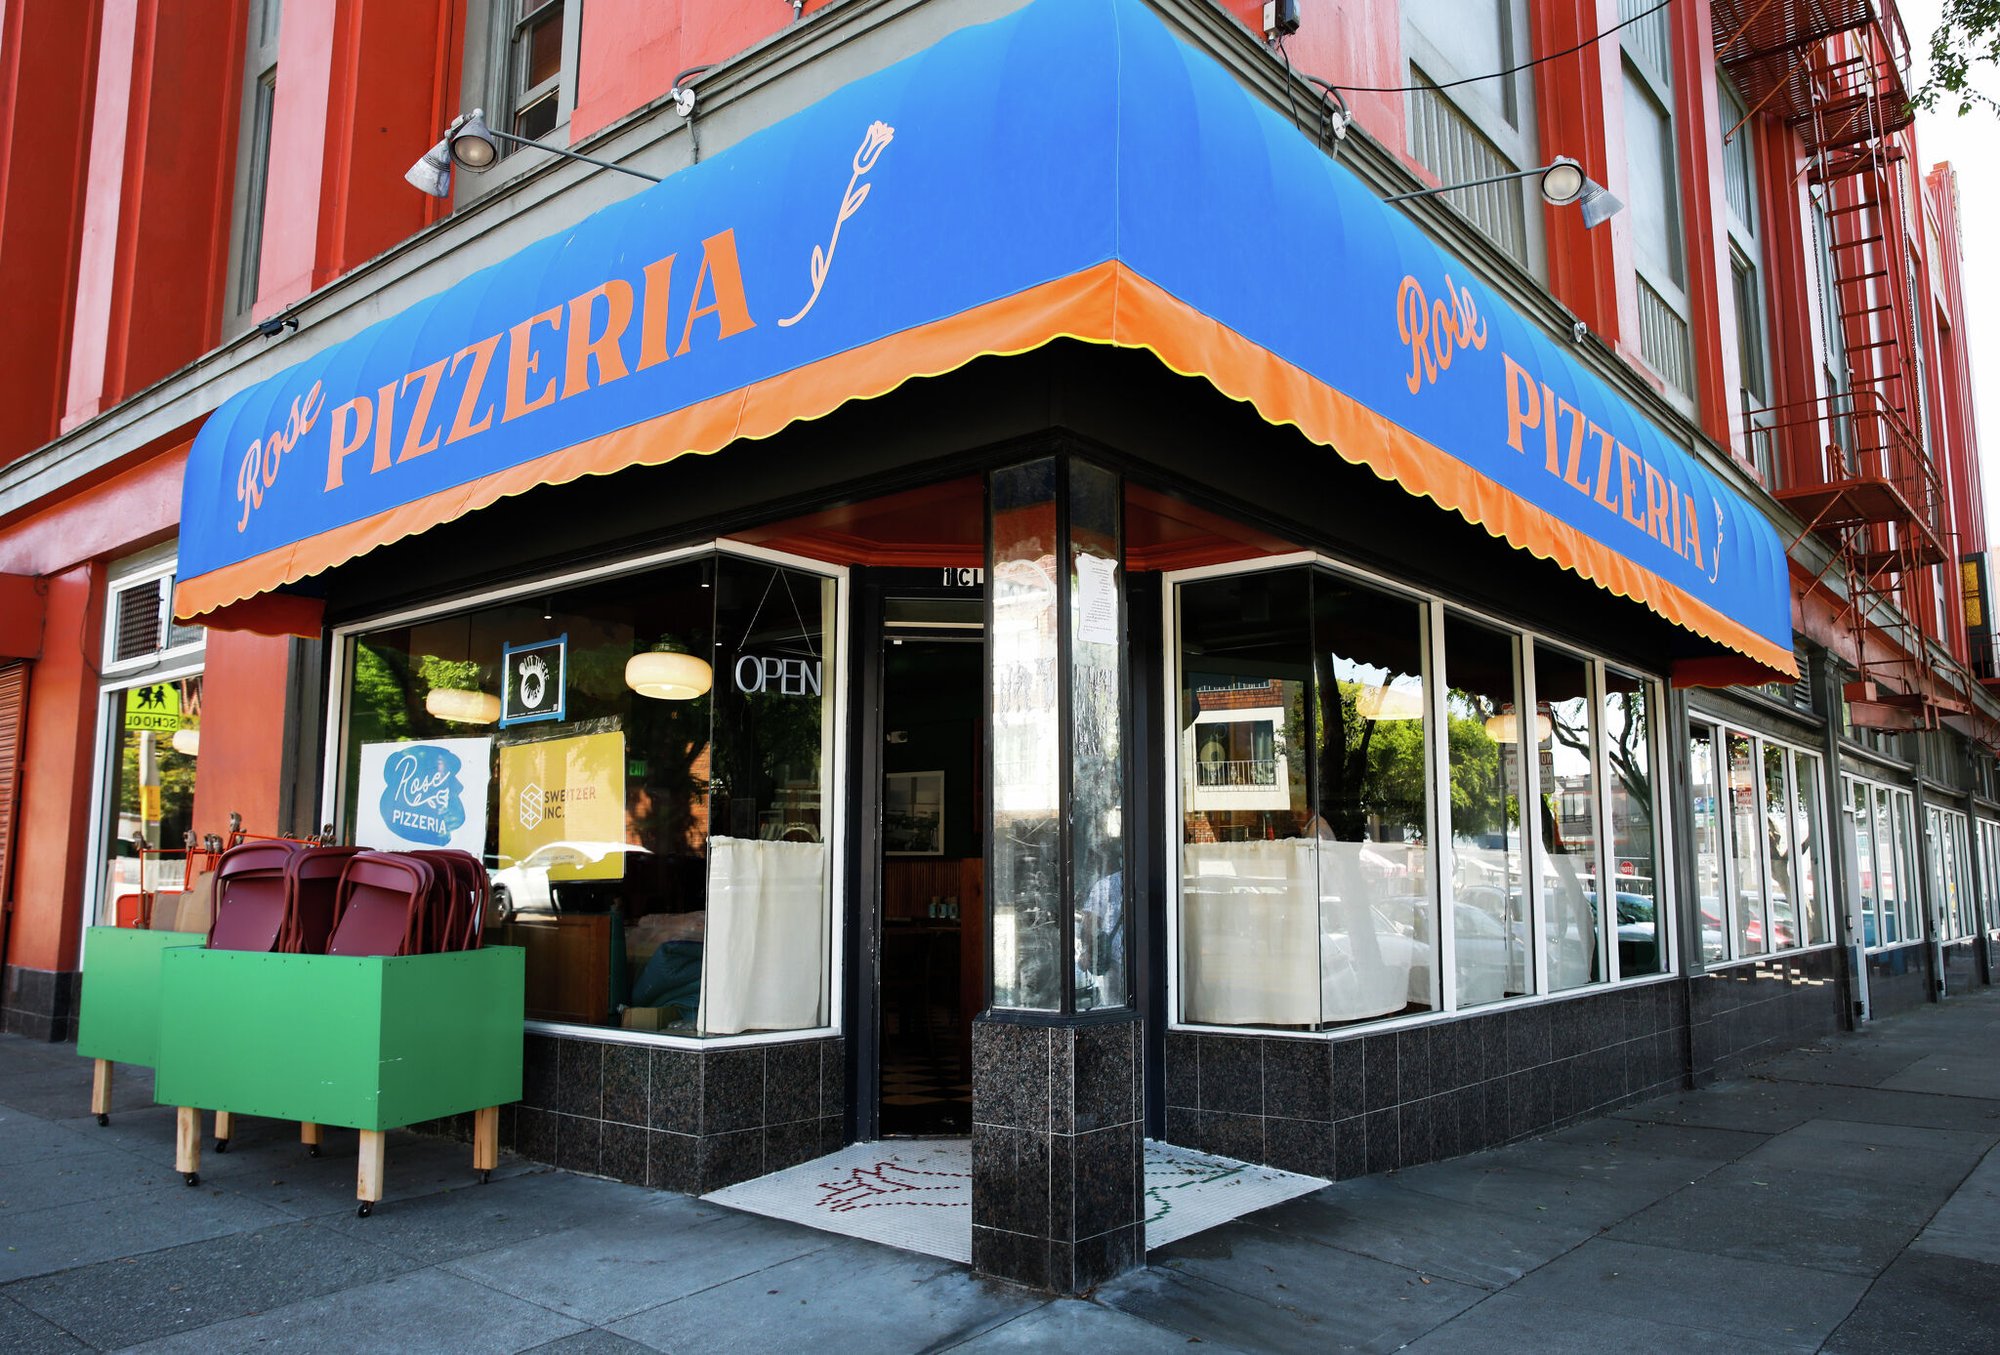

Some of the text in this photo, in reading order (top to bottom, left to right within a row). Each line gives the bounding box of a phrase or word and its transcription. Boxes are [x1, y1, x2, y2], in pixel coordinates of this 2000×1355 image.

[236, 227, 757, 533] Rose PIZZERIA
[1396, 273, 1706, 571] Rose PIZZERIA
[735, 655, 821, 697] OPEN
[394, 755, 451, 806] Rose
[544, 786, 596, 804] SWEITZER
[392, 810, 447, 835] PIZZERIA
[544, 805, 565, 819] INC.
